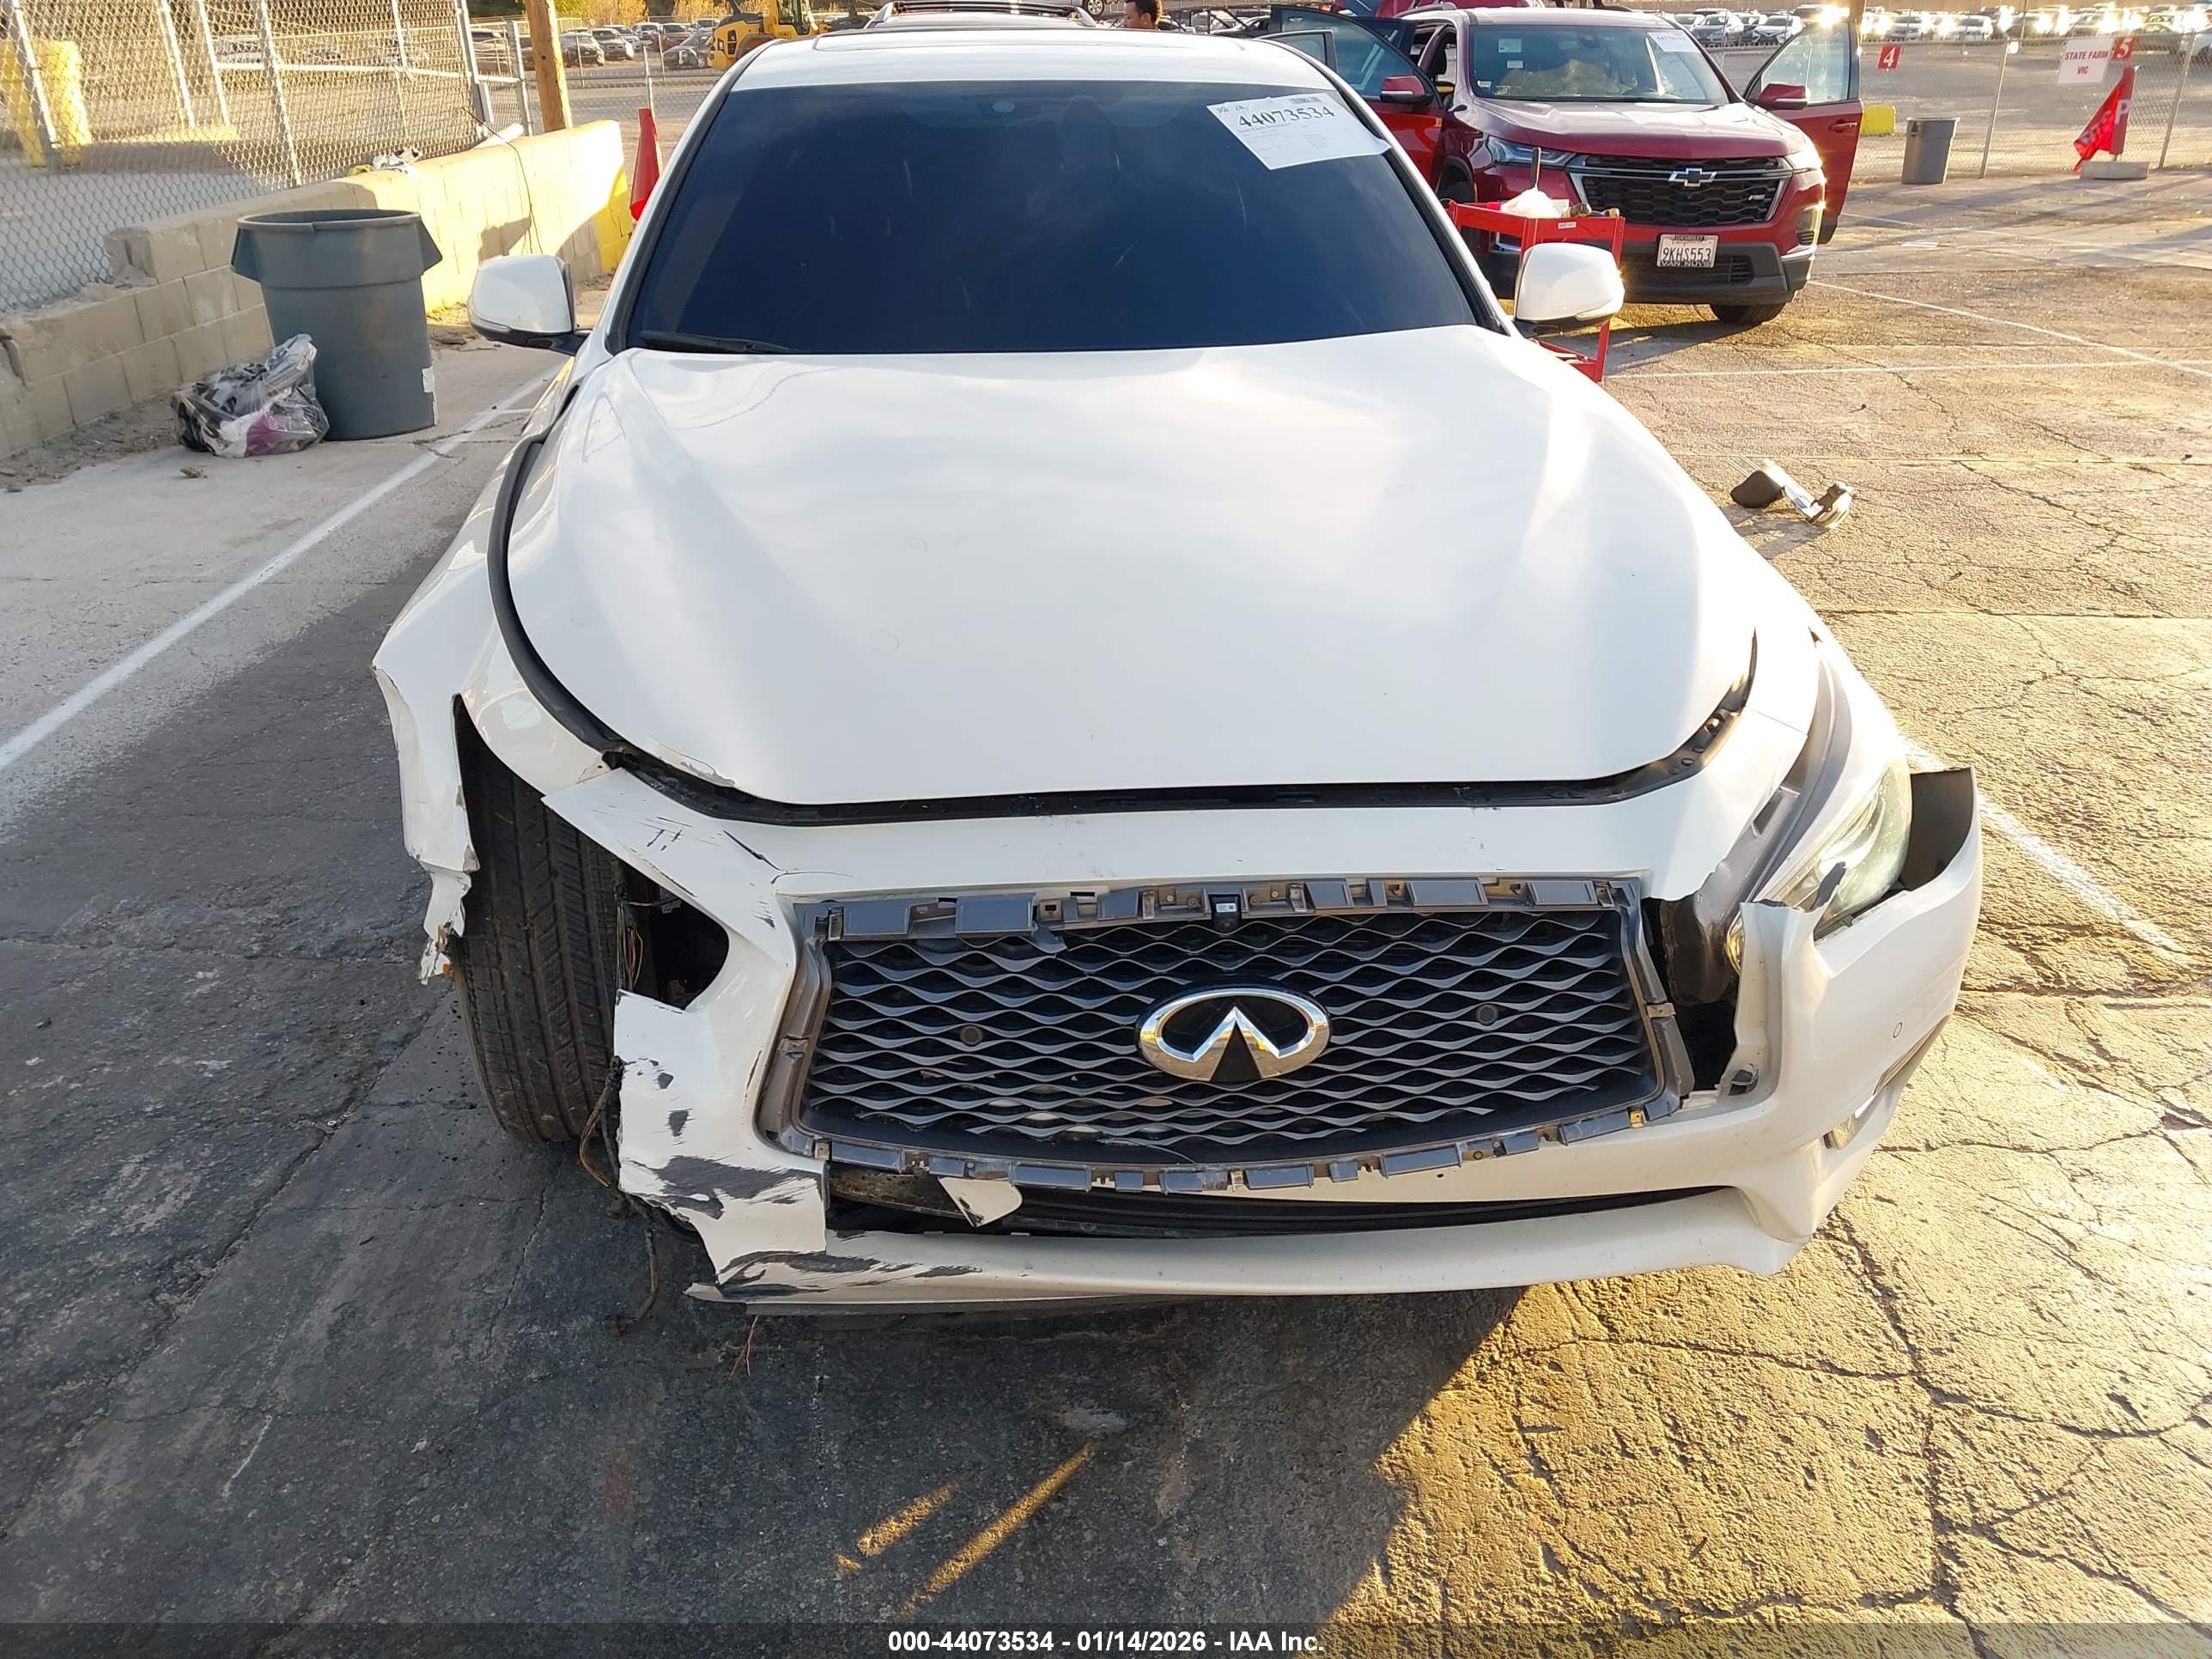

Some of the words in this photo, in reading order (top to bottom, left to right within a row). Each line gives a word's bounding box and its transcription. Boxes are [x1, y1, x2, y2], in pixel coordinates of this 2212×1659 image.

[1882, 46, 1896, 67] 4
[2064, 52, 2087, 60] STATE
[2087, 51, 2109, 59] FARM
[2116, 38, 2131, 58] 5
[2077, 65, 2089, 75] VIC
[1238, 106, 1335, 127] 44073534
[1662, 246, 1711, 262] 9KHS553
